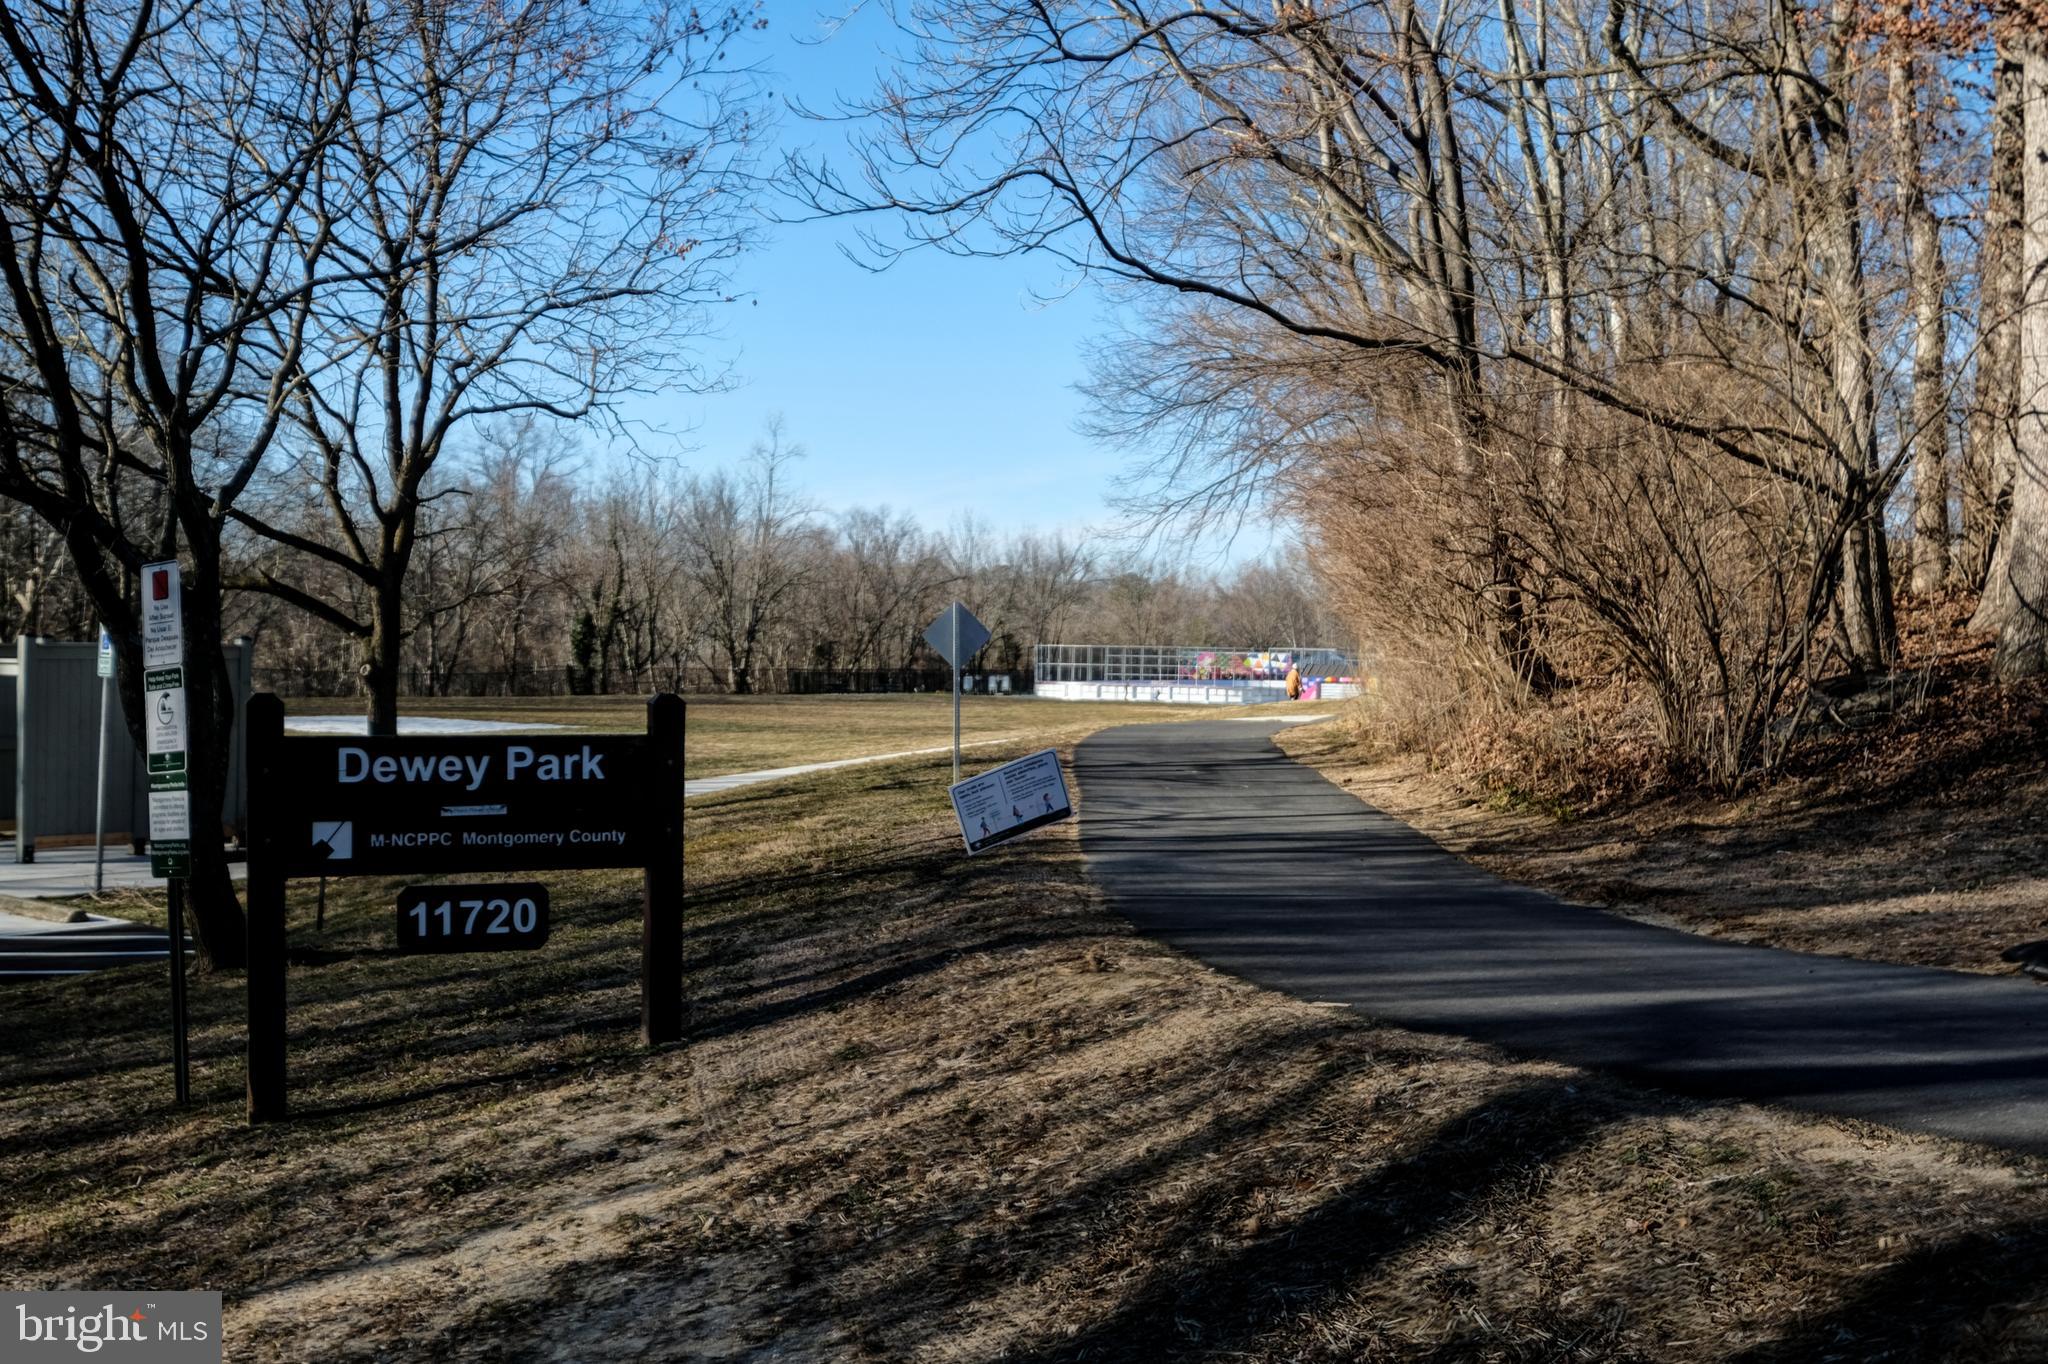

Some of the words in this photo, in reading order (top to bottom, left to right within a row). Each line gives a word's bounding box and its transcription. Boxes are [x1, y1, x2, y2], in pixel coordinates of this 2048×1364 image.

[338, 747, 490, 791] Dewey
[506, 745, 605, 781] Park
[371, 832, 452, 848] M-NCPPC
[462, 831, 564, 848] Montgomery
[569, 829, 626, 846] County
[409, 898, 537, 937] 11720
